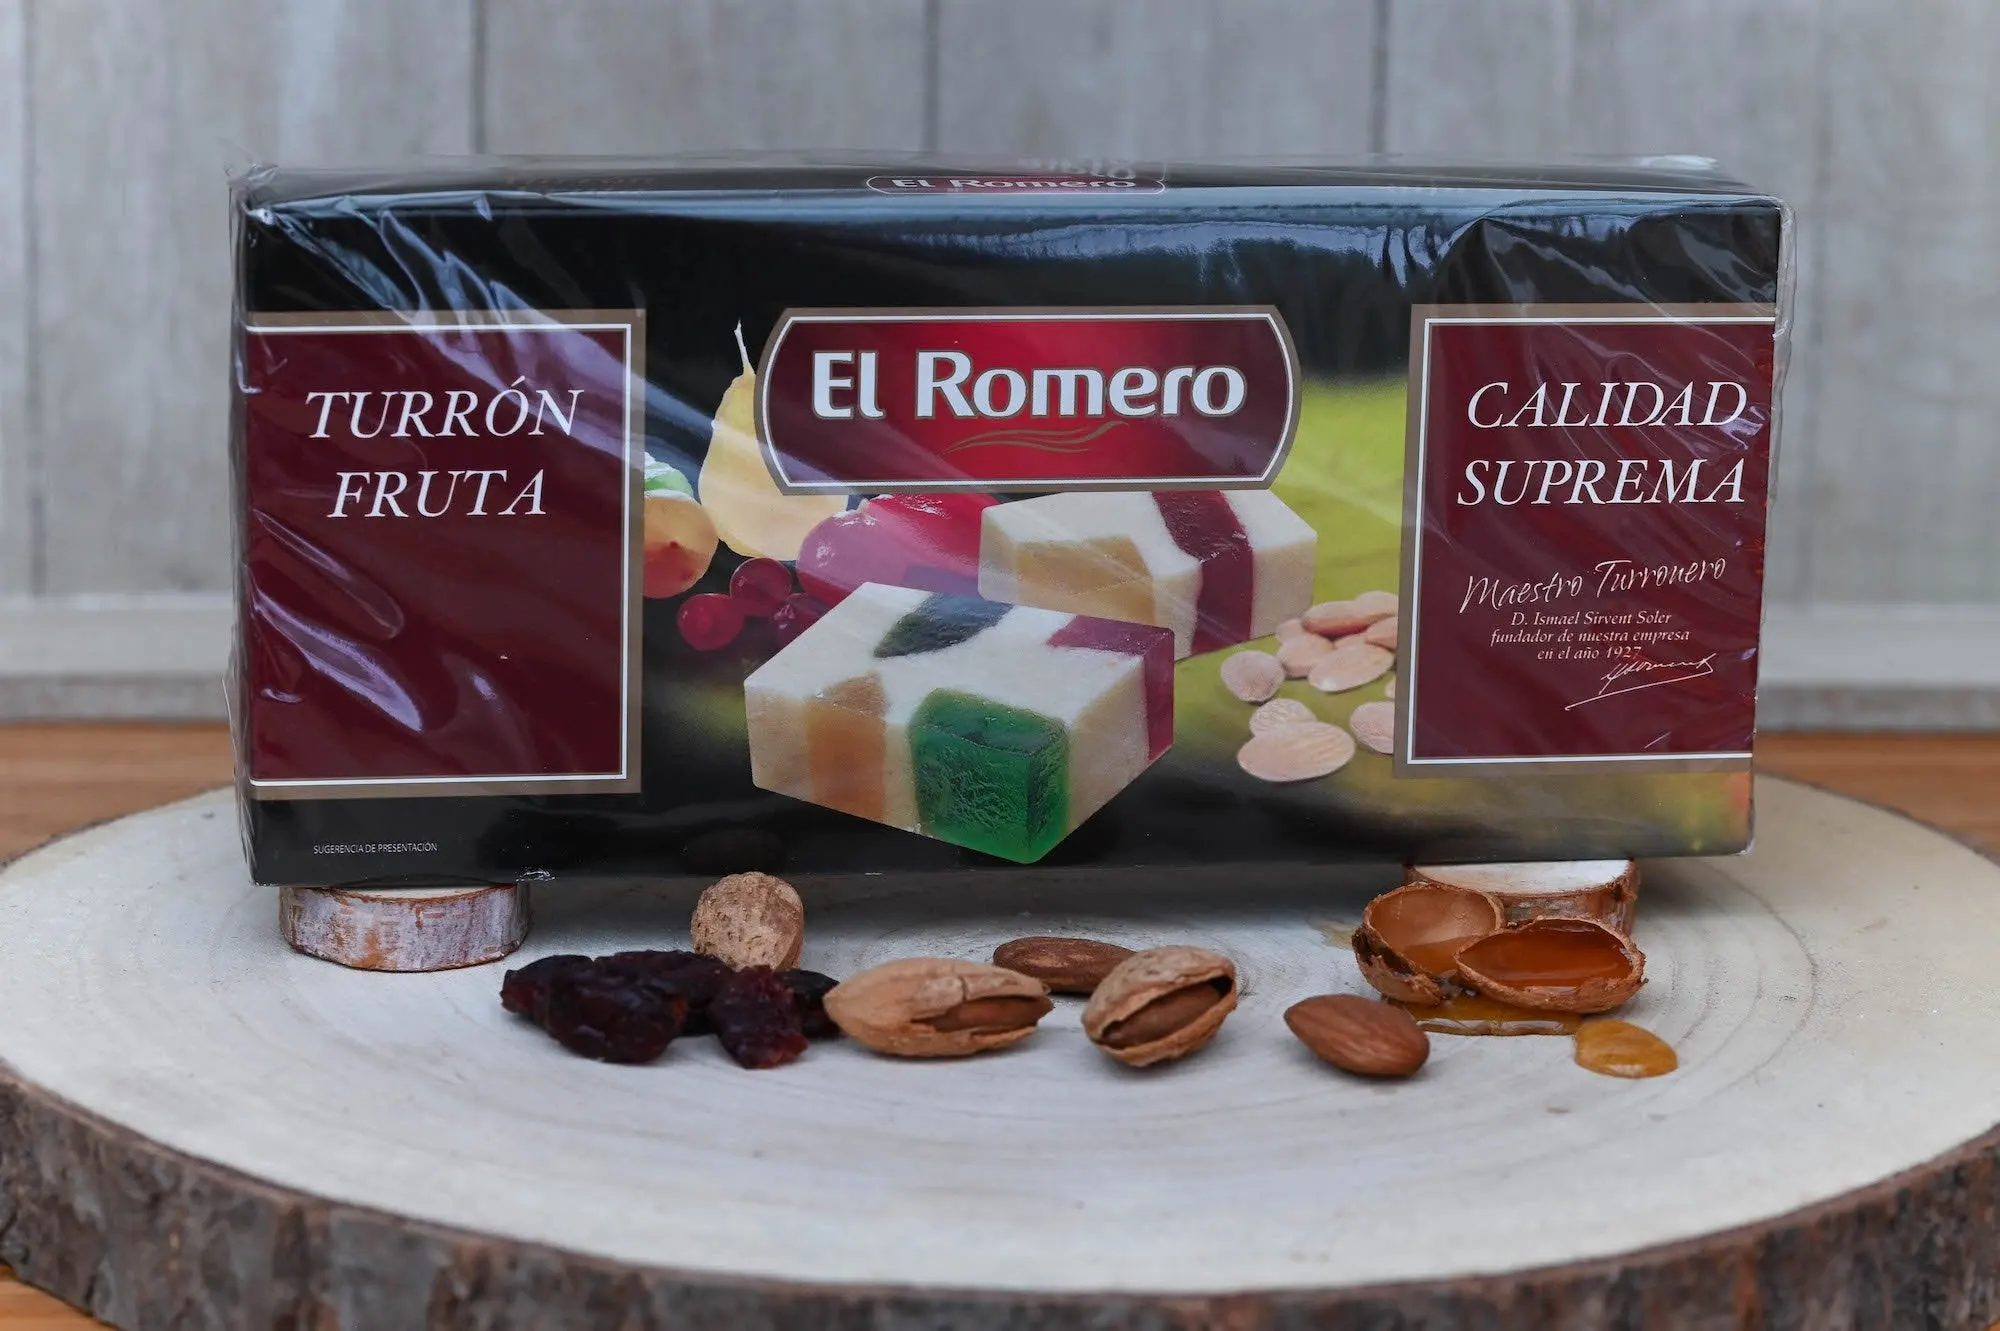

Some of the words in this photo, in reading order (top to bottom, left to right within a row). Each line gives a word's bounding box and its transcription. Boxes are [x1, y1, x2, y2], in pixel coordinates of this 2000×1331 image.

[950, 178, 1137, 188] Romero
[305, 376, 584, 438] TURRÓN
[812, 350, 885, 419] El
[915, 350, 1247, 419] Romero
[1467, 381, 1748, 428] CALIDAD
[327, 469, 546, 518] FRUTA
[1457, 457, 1745, 506] SUPREMA
[1459, 572, 1583, 613] Maestro
[1595, 558, 1726, 597] Turronero
[1490, 629, 1552, 646] fundador
[1557, 630, 1573, 642] de
[1578, 630, 1628, 642] nuestra
[1632, 630, 1690, 644] empresa
[1511, 612, 1528, 626] D.
[1533, 611, 1580, 626] Ismael
[1584, 611, 1632, 625] Sirvent
[1636, 610, 1671, 625] Soler
[1537, 649, 1555, 660] en
[1559, 647, 1574, 660] el
[1578, 647, 1599, 660] año
[1606, 646, 1641, 659] 1927
[313, 844, 364, 854] SUGERENCIA
[365, 844, 376, 853] DE
